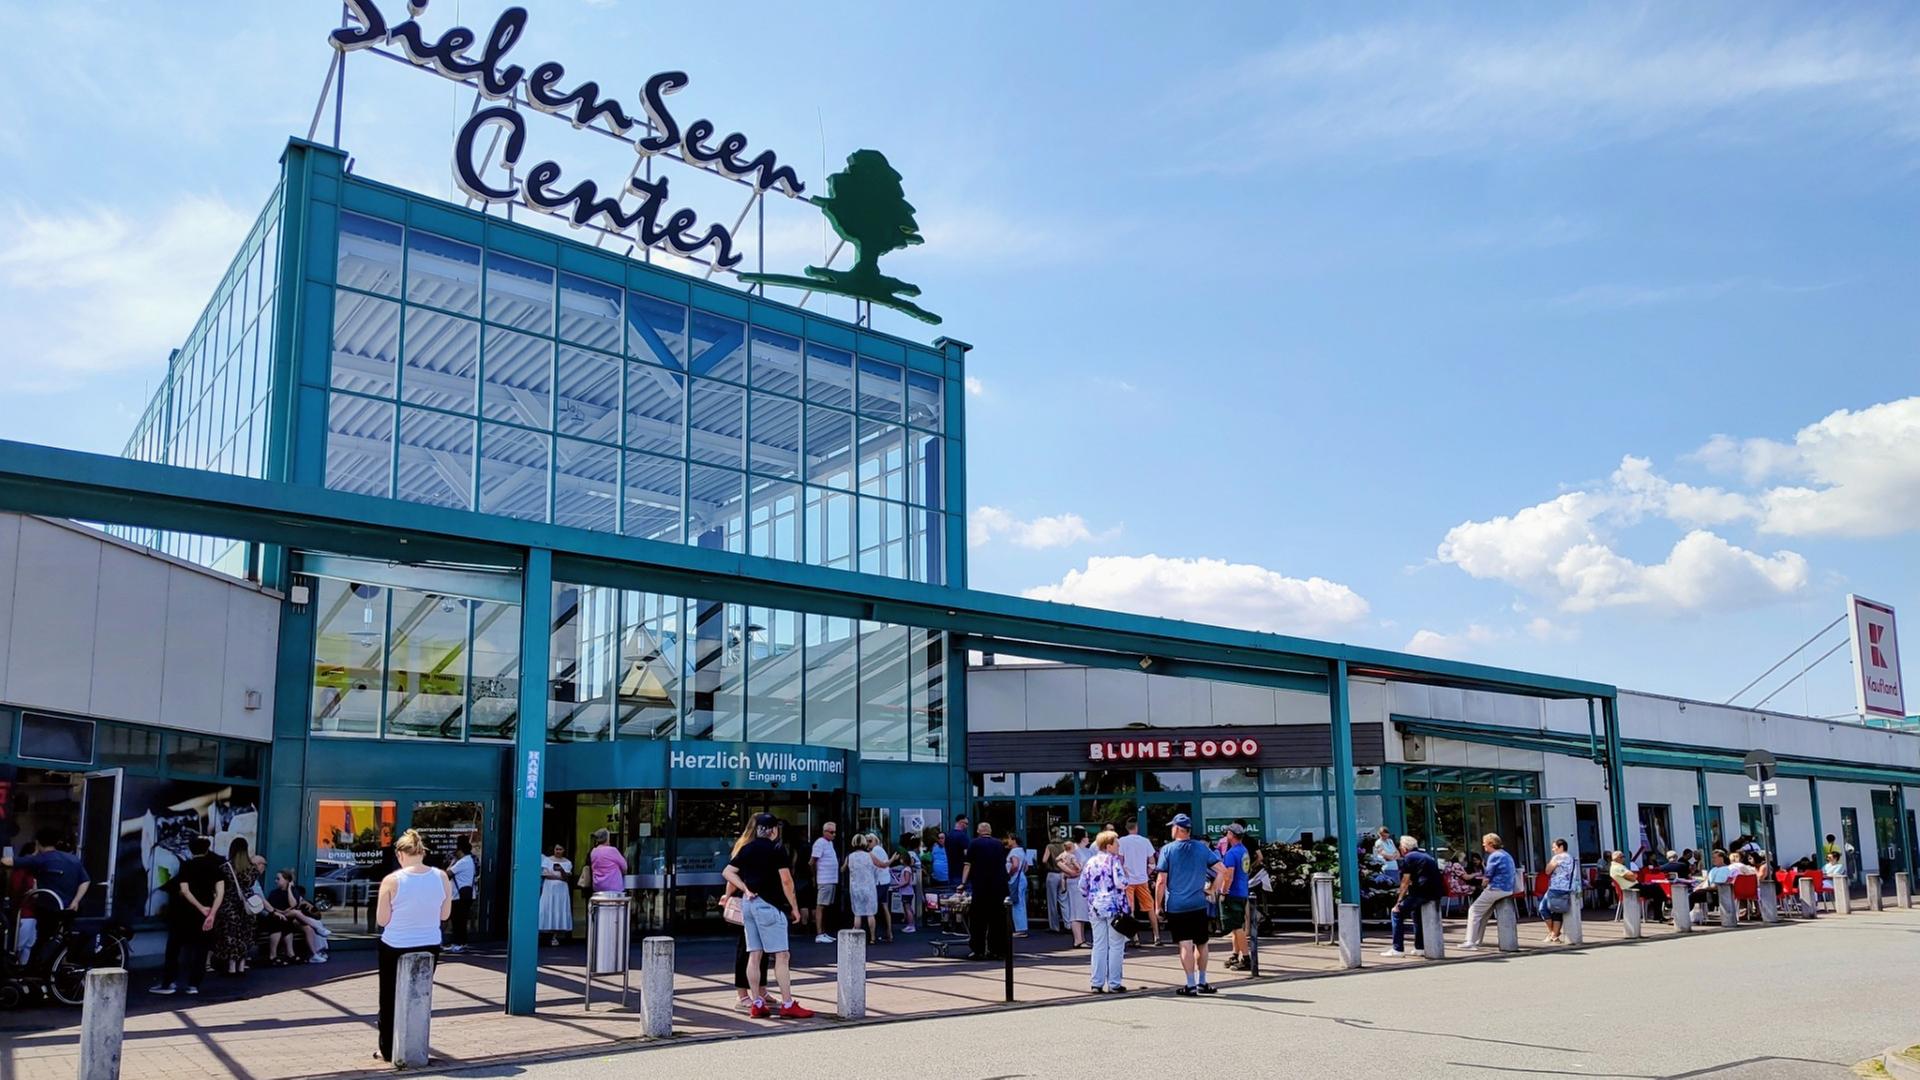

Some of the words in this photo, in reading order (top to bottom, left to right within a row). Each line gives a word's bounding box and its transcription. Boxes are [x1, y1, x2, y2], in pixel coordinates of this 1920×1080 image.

[451, 105, 744, 272] Center
[1866, 676, 1898, 696] Kaufland
[1089, 741, 1170, 760] BLUME
[1184, 739, 1258, 758] 2000
[670, 751, 750, 769] Herzlich
[756, 752, 845, 774] Willkommen!
[748, 771, 786, 783] Eingang
[790, 773, 797, 782] B
